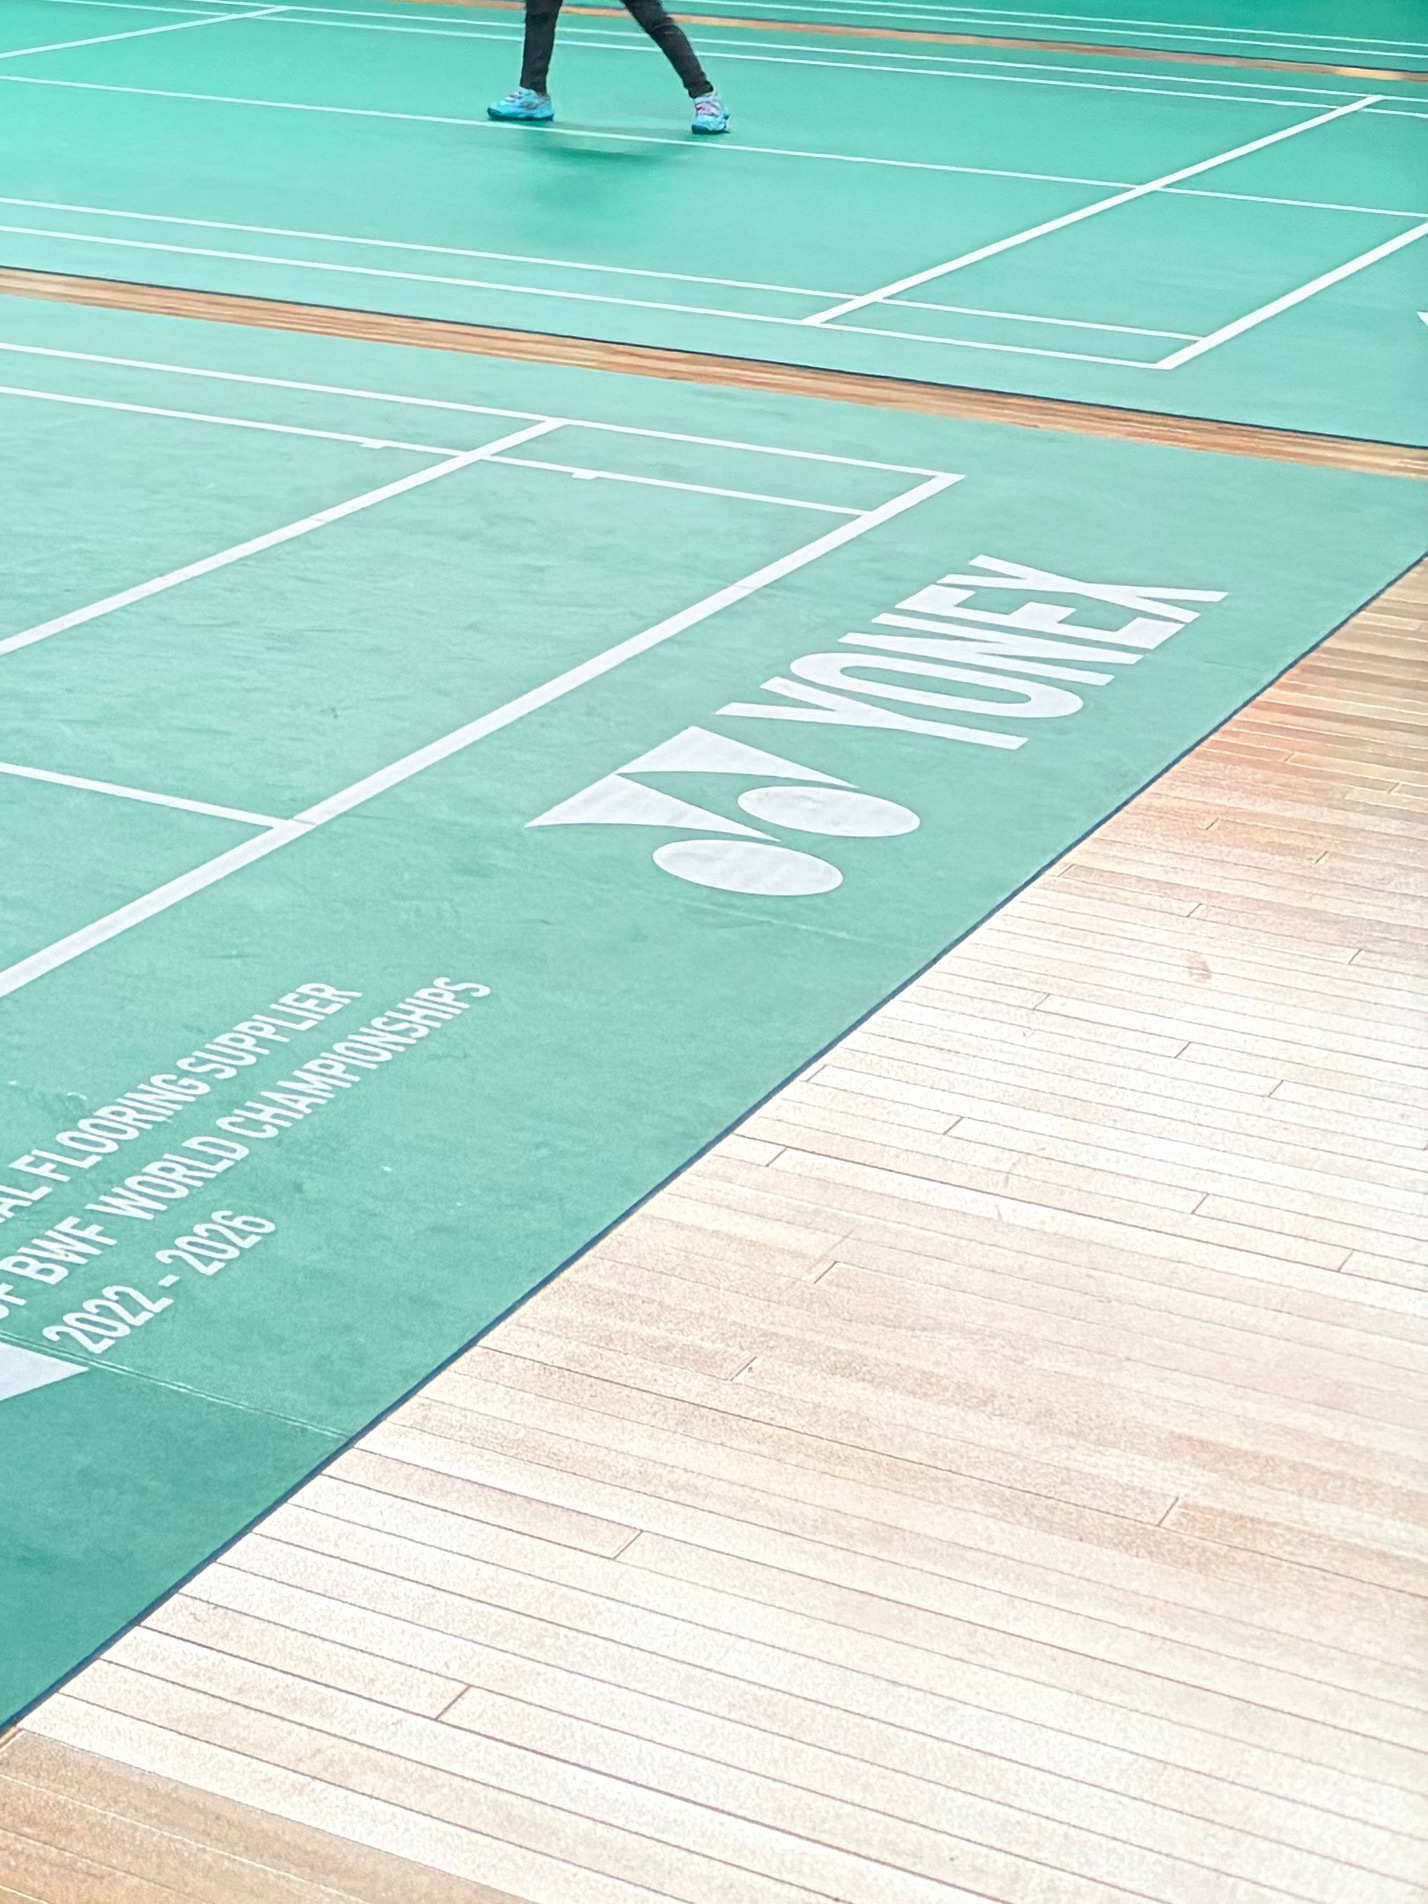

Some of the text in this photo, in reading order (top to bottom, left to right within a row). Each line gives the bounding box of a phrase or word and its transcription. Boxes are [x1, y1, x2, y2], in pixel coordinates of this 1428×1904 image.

[714, 553, 1230, 751] YONEX
[7, 1073, 212, 1182] FLOORING
[175, 982, 363, 1080] SUPPLIER
[84, 1135, 249, 1221] WORLD
[215, 976, 492, 1140] CHAMPIONSHIPS
[42, 1285, 174, 1354] 2022
[154, 1209, 276, 1276] 2026
